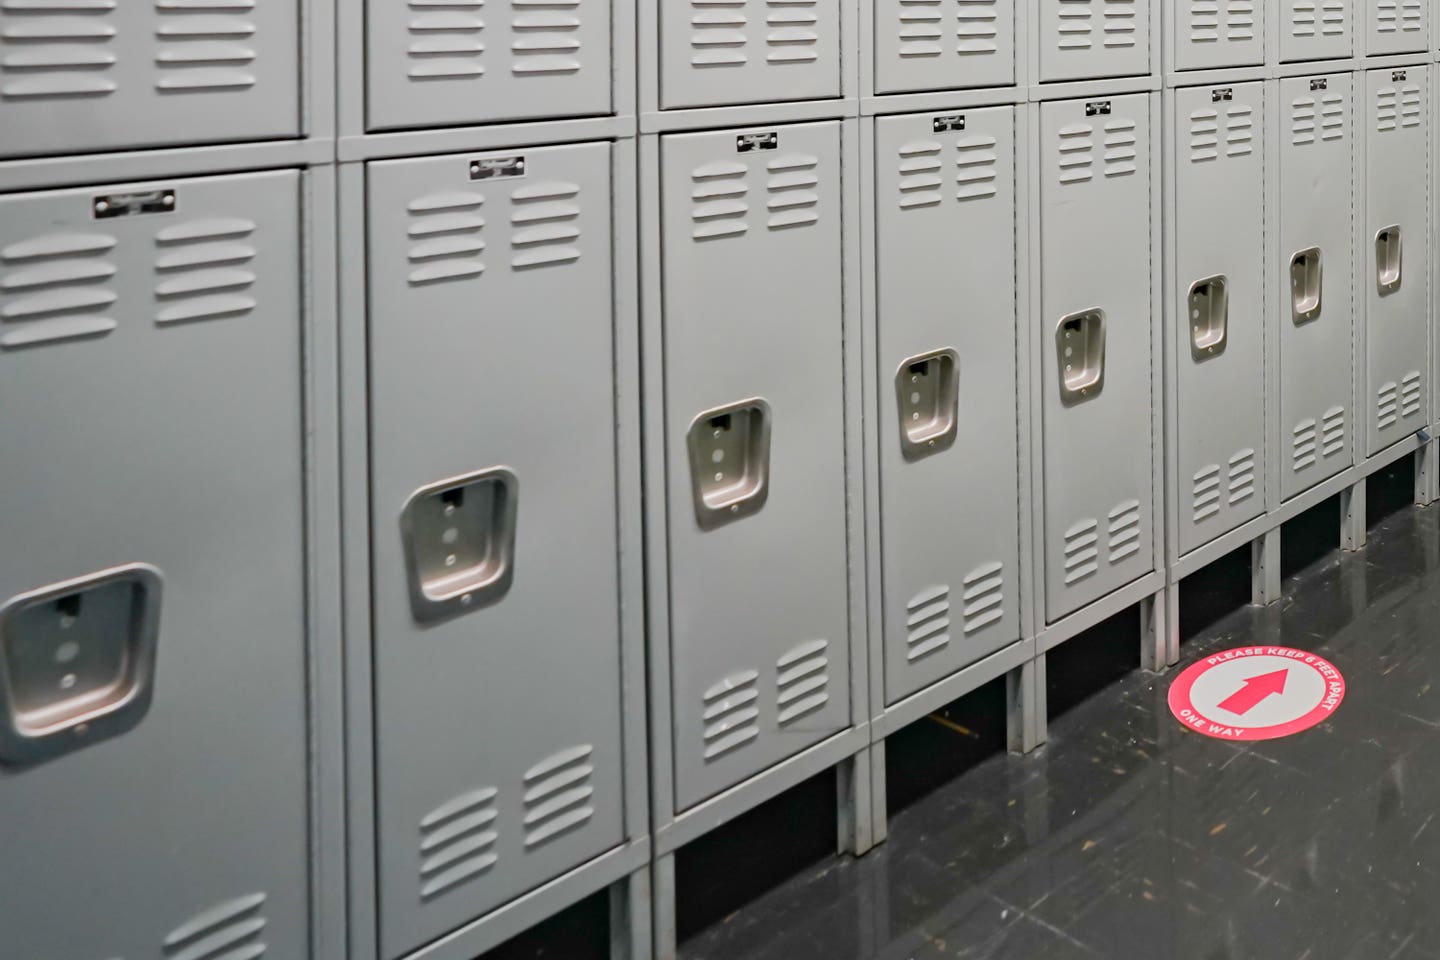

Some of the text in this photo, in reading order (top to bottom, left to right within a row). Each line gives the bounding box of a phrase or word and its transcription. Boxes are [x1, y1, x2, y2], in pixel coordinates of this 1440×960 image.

[1207, 647, 1343, 711] PLEASE KEEP 6 FEET APART
[1179, 709, 1245, 737] ONE WAY
